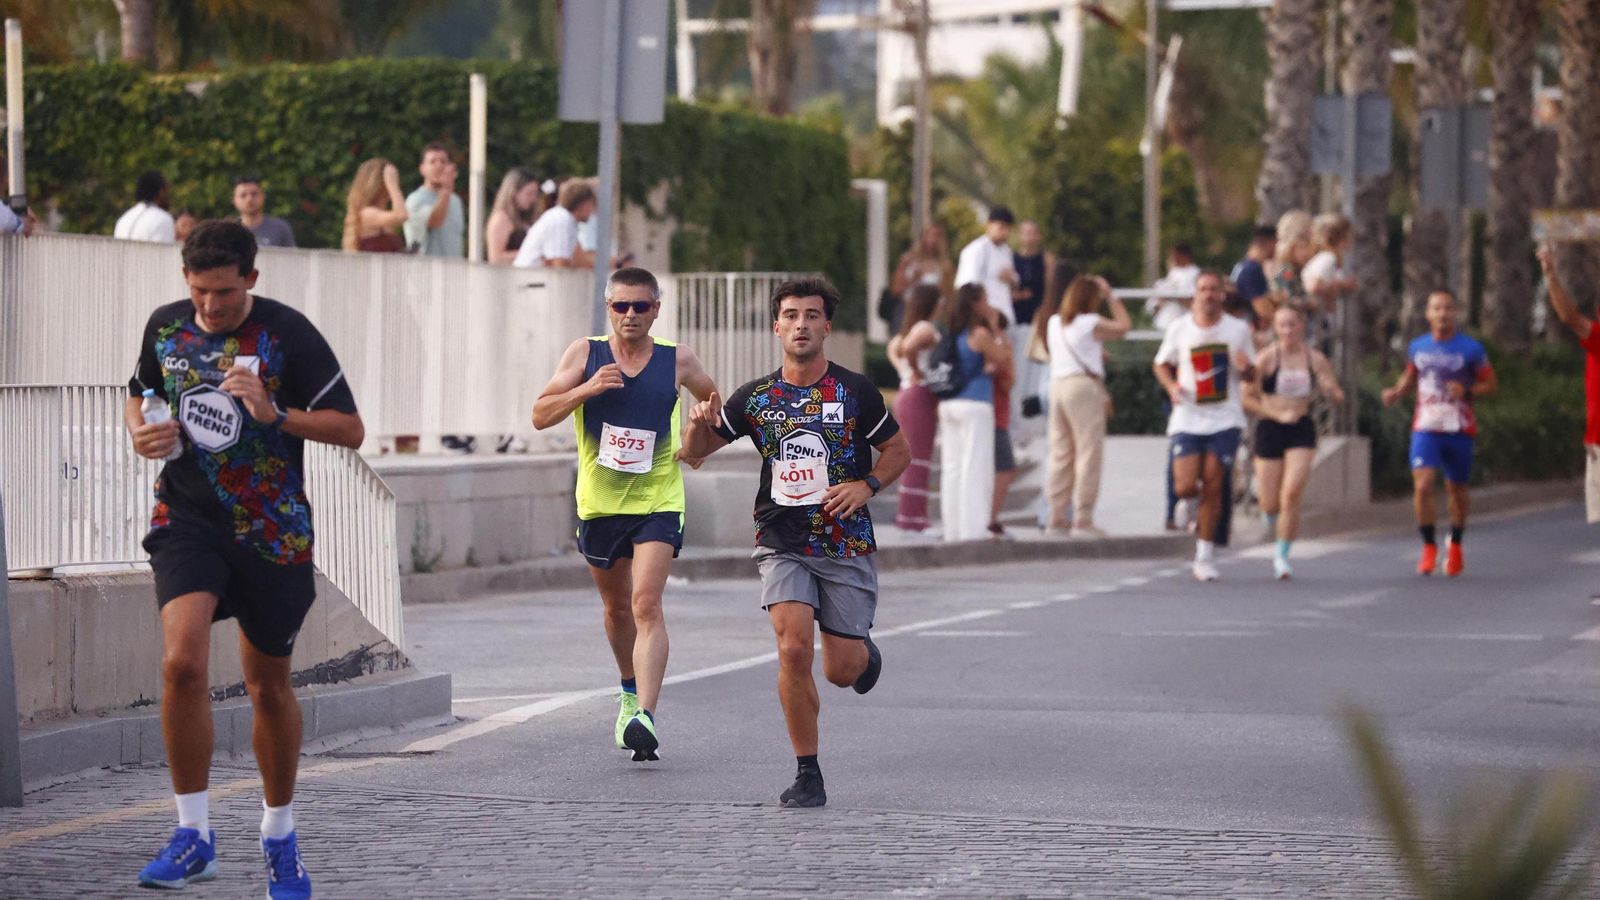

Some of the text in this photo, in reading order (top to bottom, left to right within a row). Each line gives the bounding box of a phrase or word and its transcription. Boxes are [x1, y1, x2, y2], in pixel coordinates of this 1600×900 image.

[189, 399, 234, 425] PONLE
[822, 412, 841, 422] AXA
[187, 411, 231, 436] FRENO
[609, 433, 645, 451] 3673
[786, 442, 824, 458] PONLE
[779, 468, 815, 483] 4011
